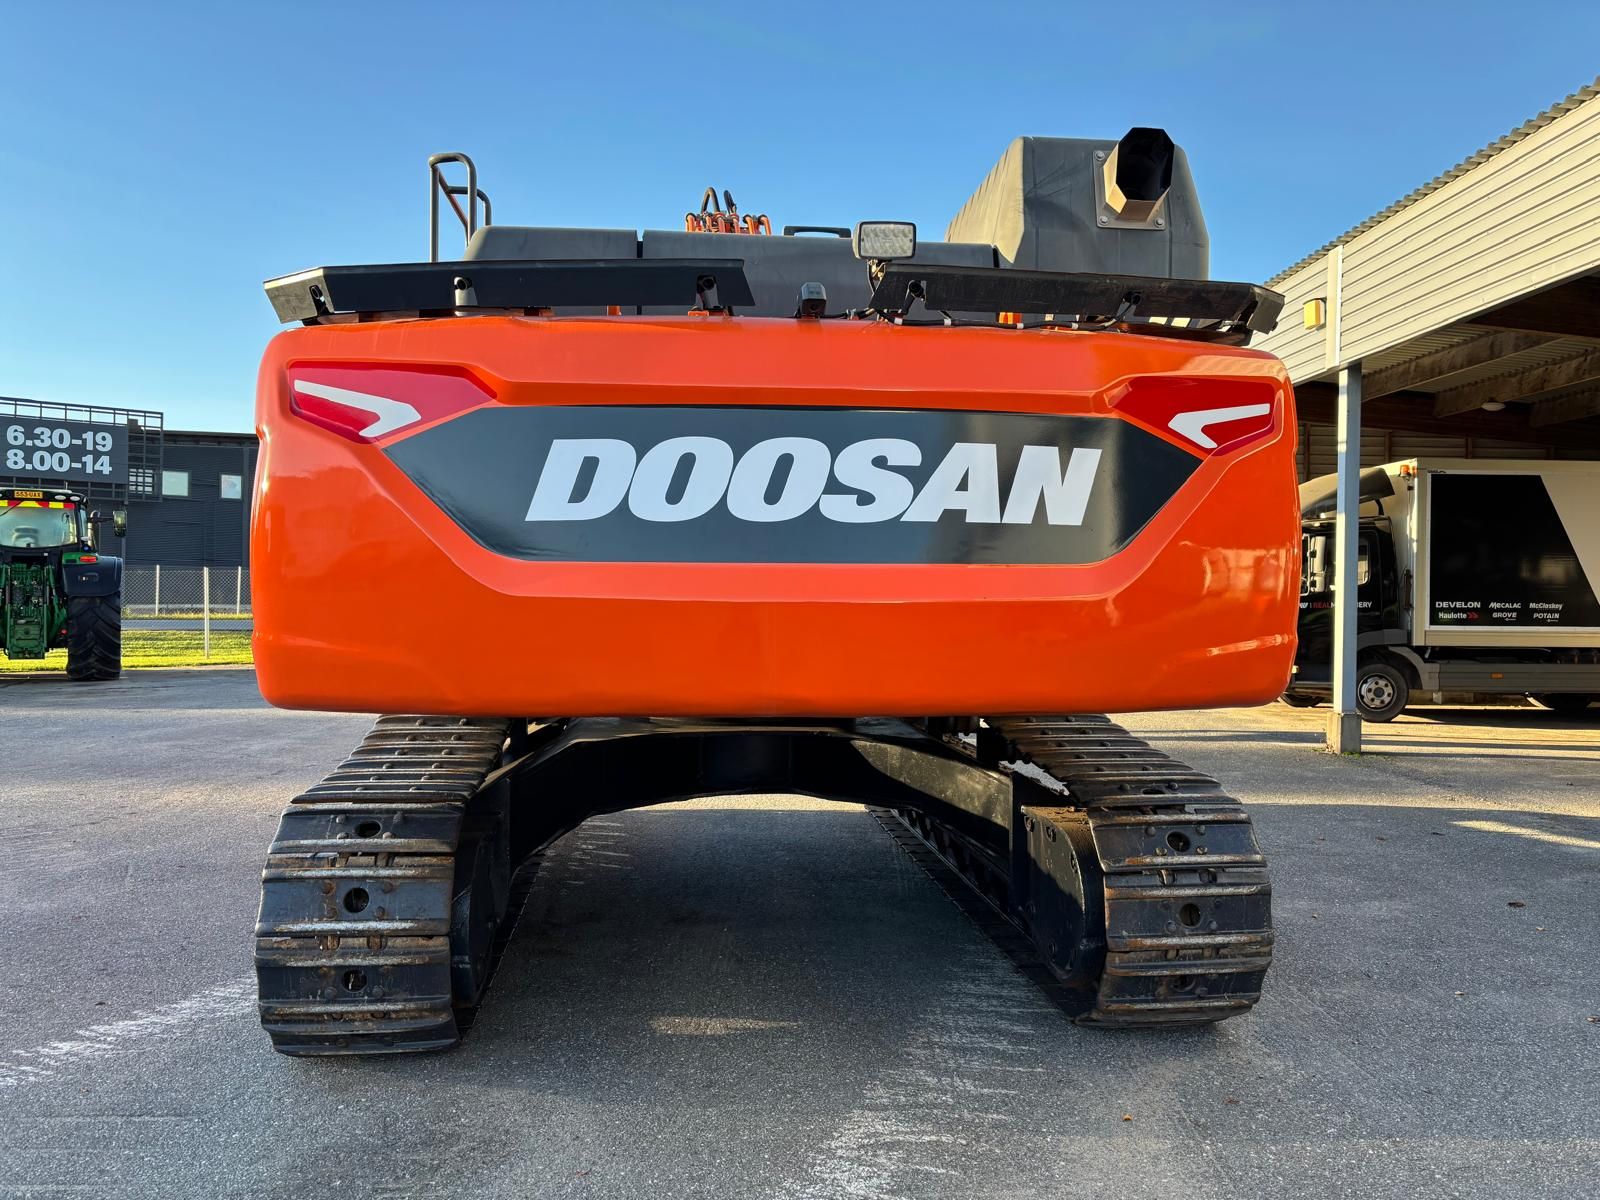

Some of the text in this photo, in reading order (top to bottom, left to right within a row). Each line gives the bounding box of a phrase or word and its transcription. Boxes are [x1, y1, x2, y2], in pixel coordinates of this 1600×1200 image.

[6, 425, 113, 452] 6.30-19
[6, 449, 113, 475] 8.00-14
[525, 436, 1103, 526] DOOSAN
[1435, 601, 1481, 609] DEVELON
[1529, 602, 1563, 611] McCloskey
[1438, 611, 1468, 619] Haulotte
